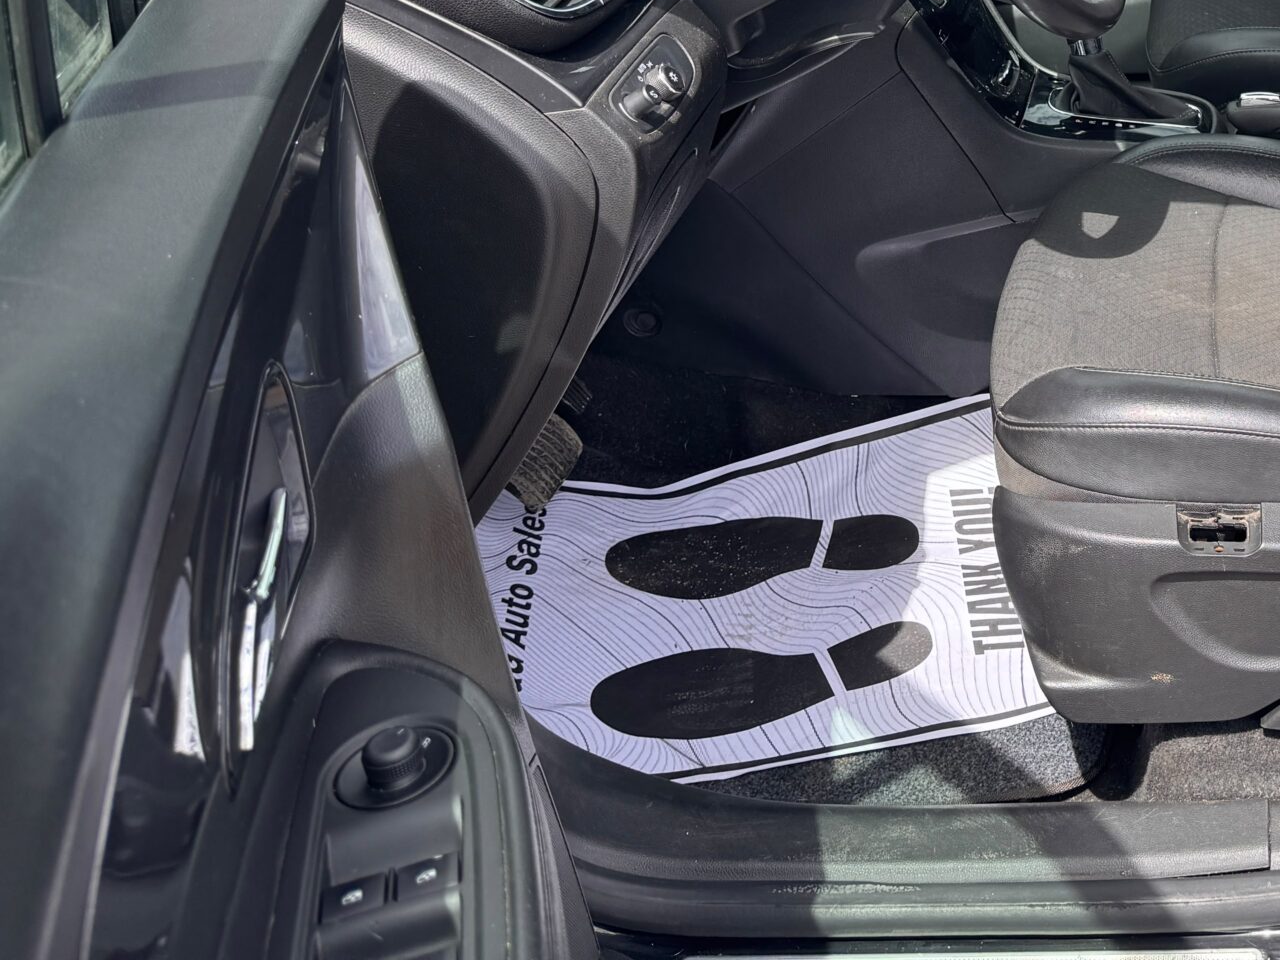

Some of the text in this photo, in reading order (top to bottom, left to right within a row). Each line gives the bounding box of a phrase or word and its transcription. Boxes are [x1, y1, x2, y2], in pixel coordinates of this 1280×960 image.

[500, 583, 534, 651] Auto
[949, 487, 1025, 655] THANK YOU!
